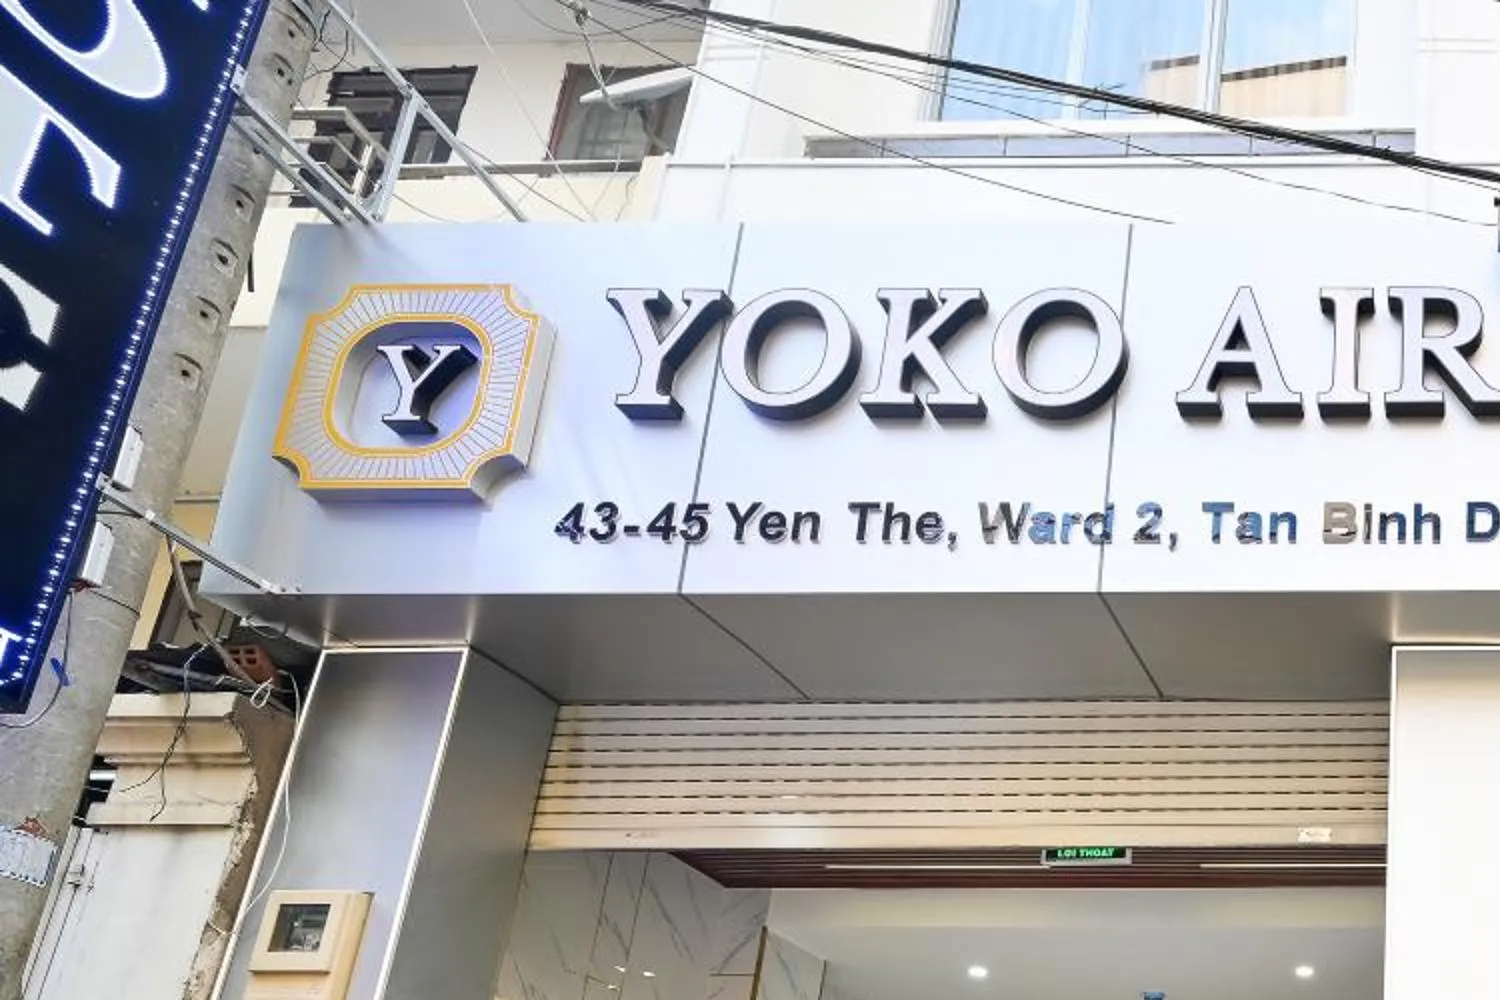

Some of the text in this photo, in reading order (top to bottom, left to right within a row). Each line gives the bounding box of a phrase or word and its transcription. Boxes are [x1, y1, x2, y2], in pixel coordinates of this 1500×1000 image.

[376, 343, 479, 435] Y
[606, 288, 1130, 421] YOKO
[554, 502, 711, 546] 43-45
[724, 502, 823, 545] Yen
[847, 502, 958, 552] The,
[977, 502, 1118, 546] Ward
[1132, 503, 1180, 551] 2,
[1201, 502, 1299, 545] Tan
[1321, 502, 1443, 546] Binh
